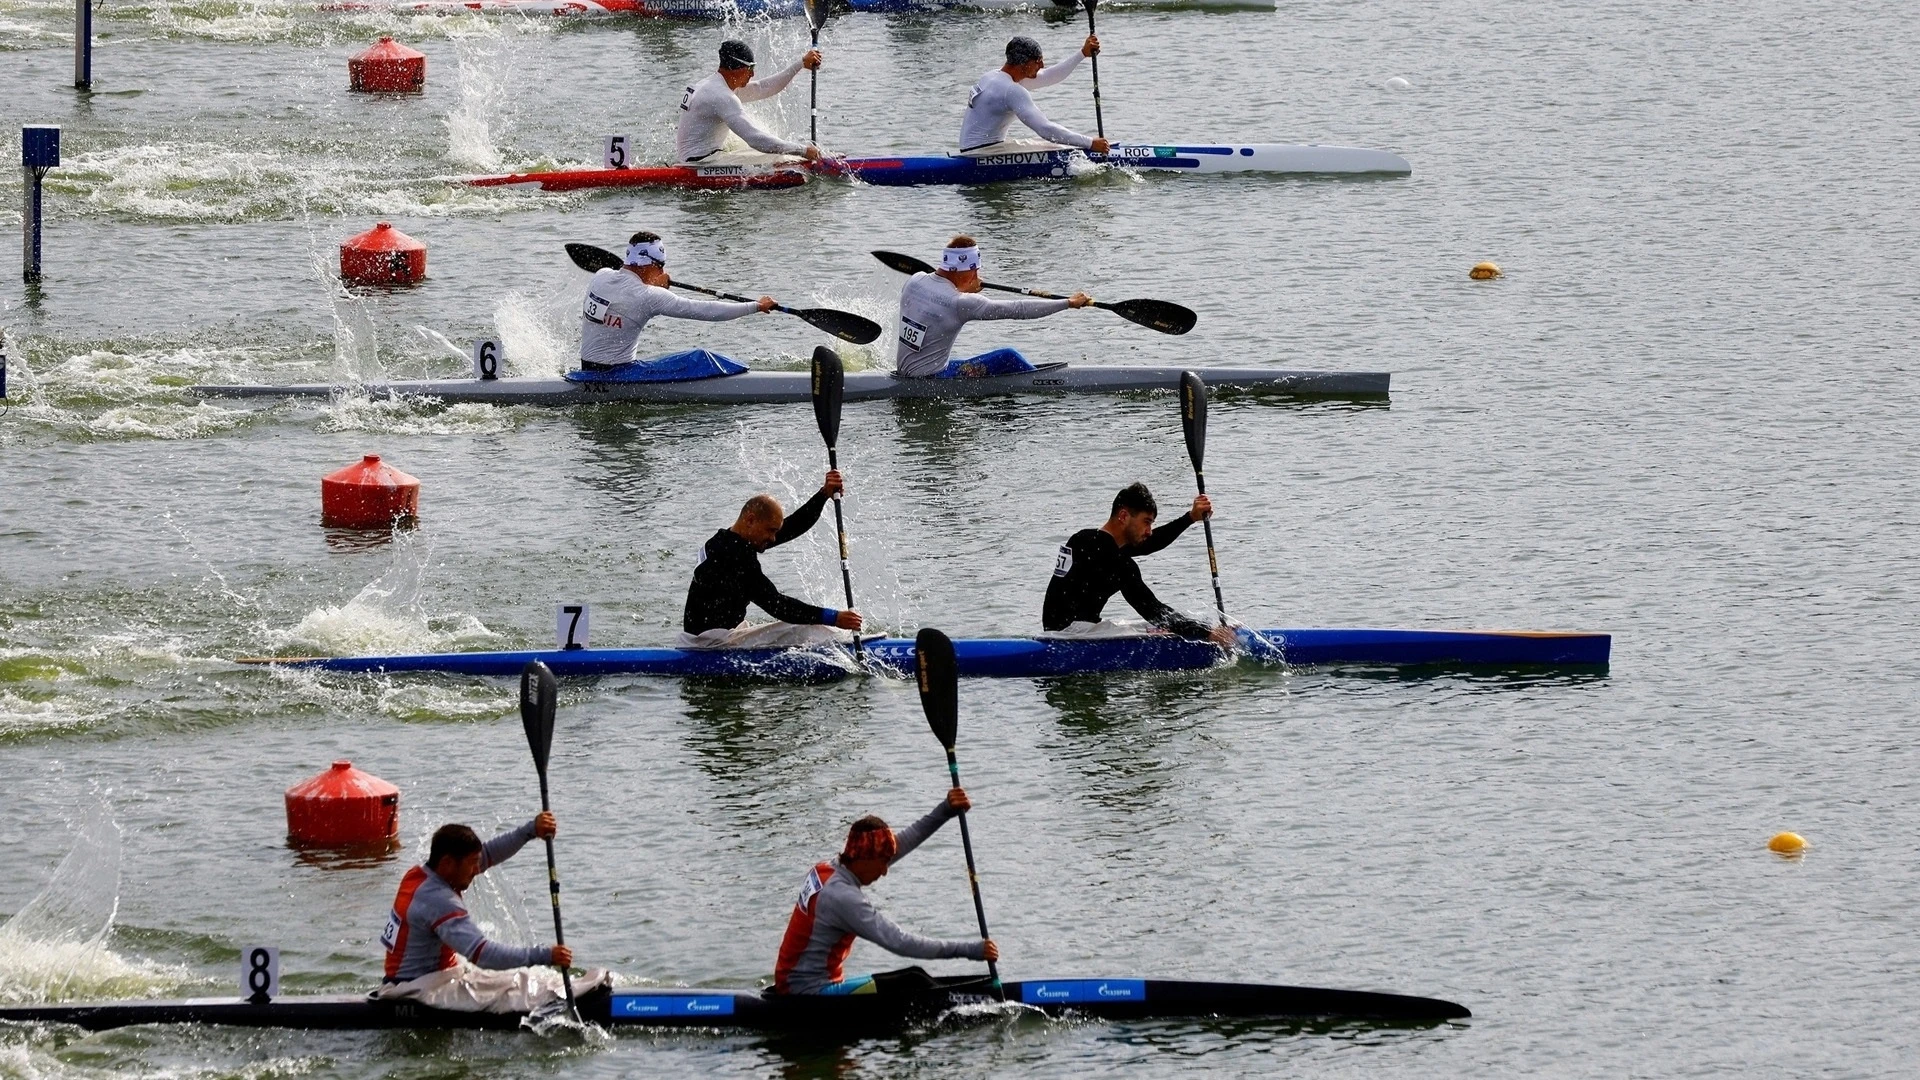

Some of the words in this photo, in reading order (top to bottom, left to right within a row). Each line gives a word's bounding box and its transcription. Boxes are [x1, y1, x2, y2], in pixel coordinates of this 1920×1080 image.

[609, 136, 625, 167] 5
[977, 153, 1033, 165] ERSHOV
[1124, 148, 1150, 157] ROC
[903, 326, 919, 343] 195
[479, 341, 497, 375] 6
[564, 606, 583, 646] 7
[249, 948, 271, 994] 8
